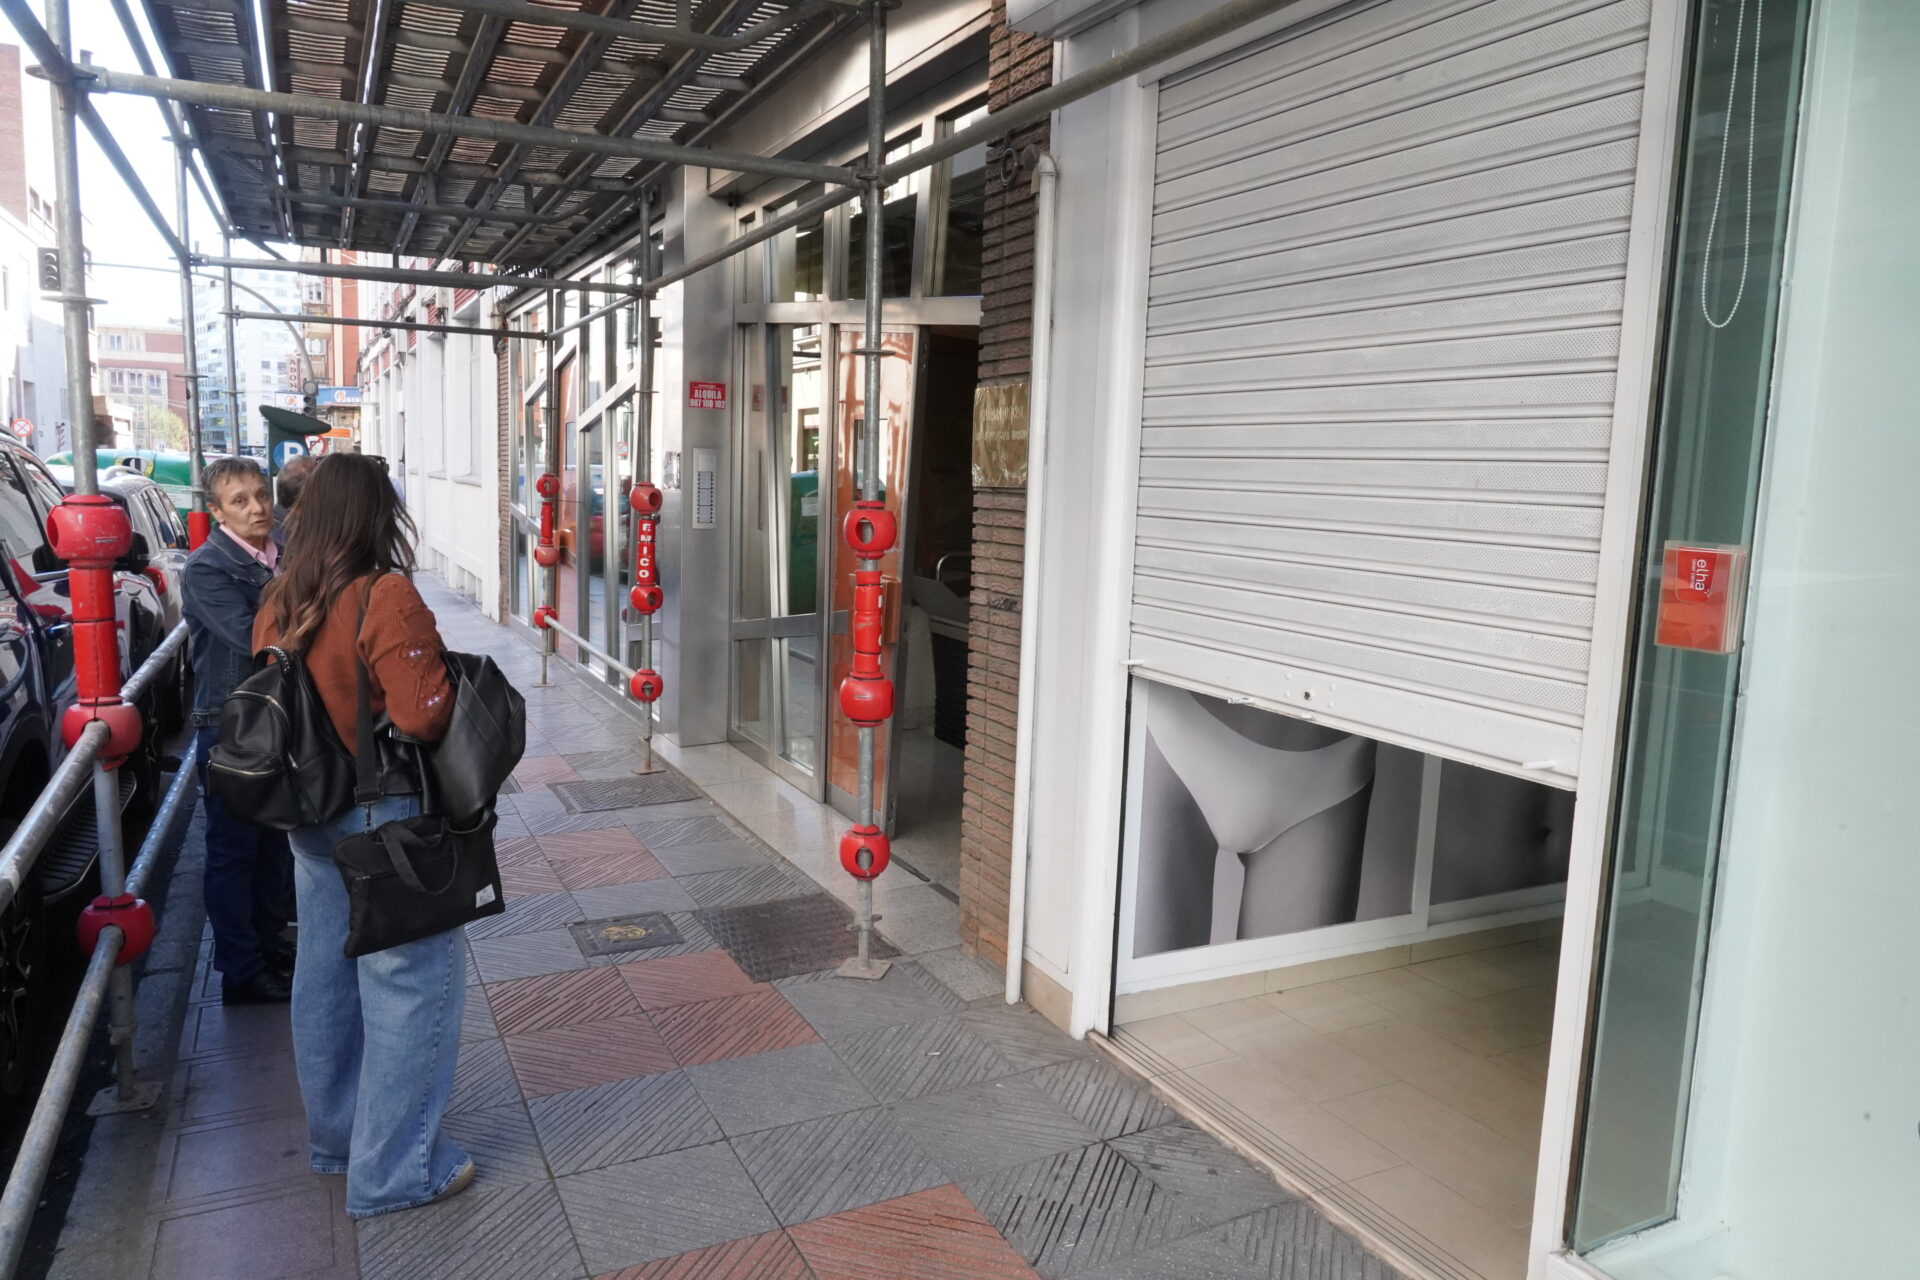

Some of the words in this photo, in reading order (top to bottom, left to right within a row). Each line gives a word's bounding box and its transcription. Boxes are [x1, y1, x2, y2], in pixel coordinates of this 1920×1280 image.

[289, 359, 297, 392] ADON
[694, 389, 722, 400] ALQUILA
[1695, 559, 1710, 591] elha
